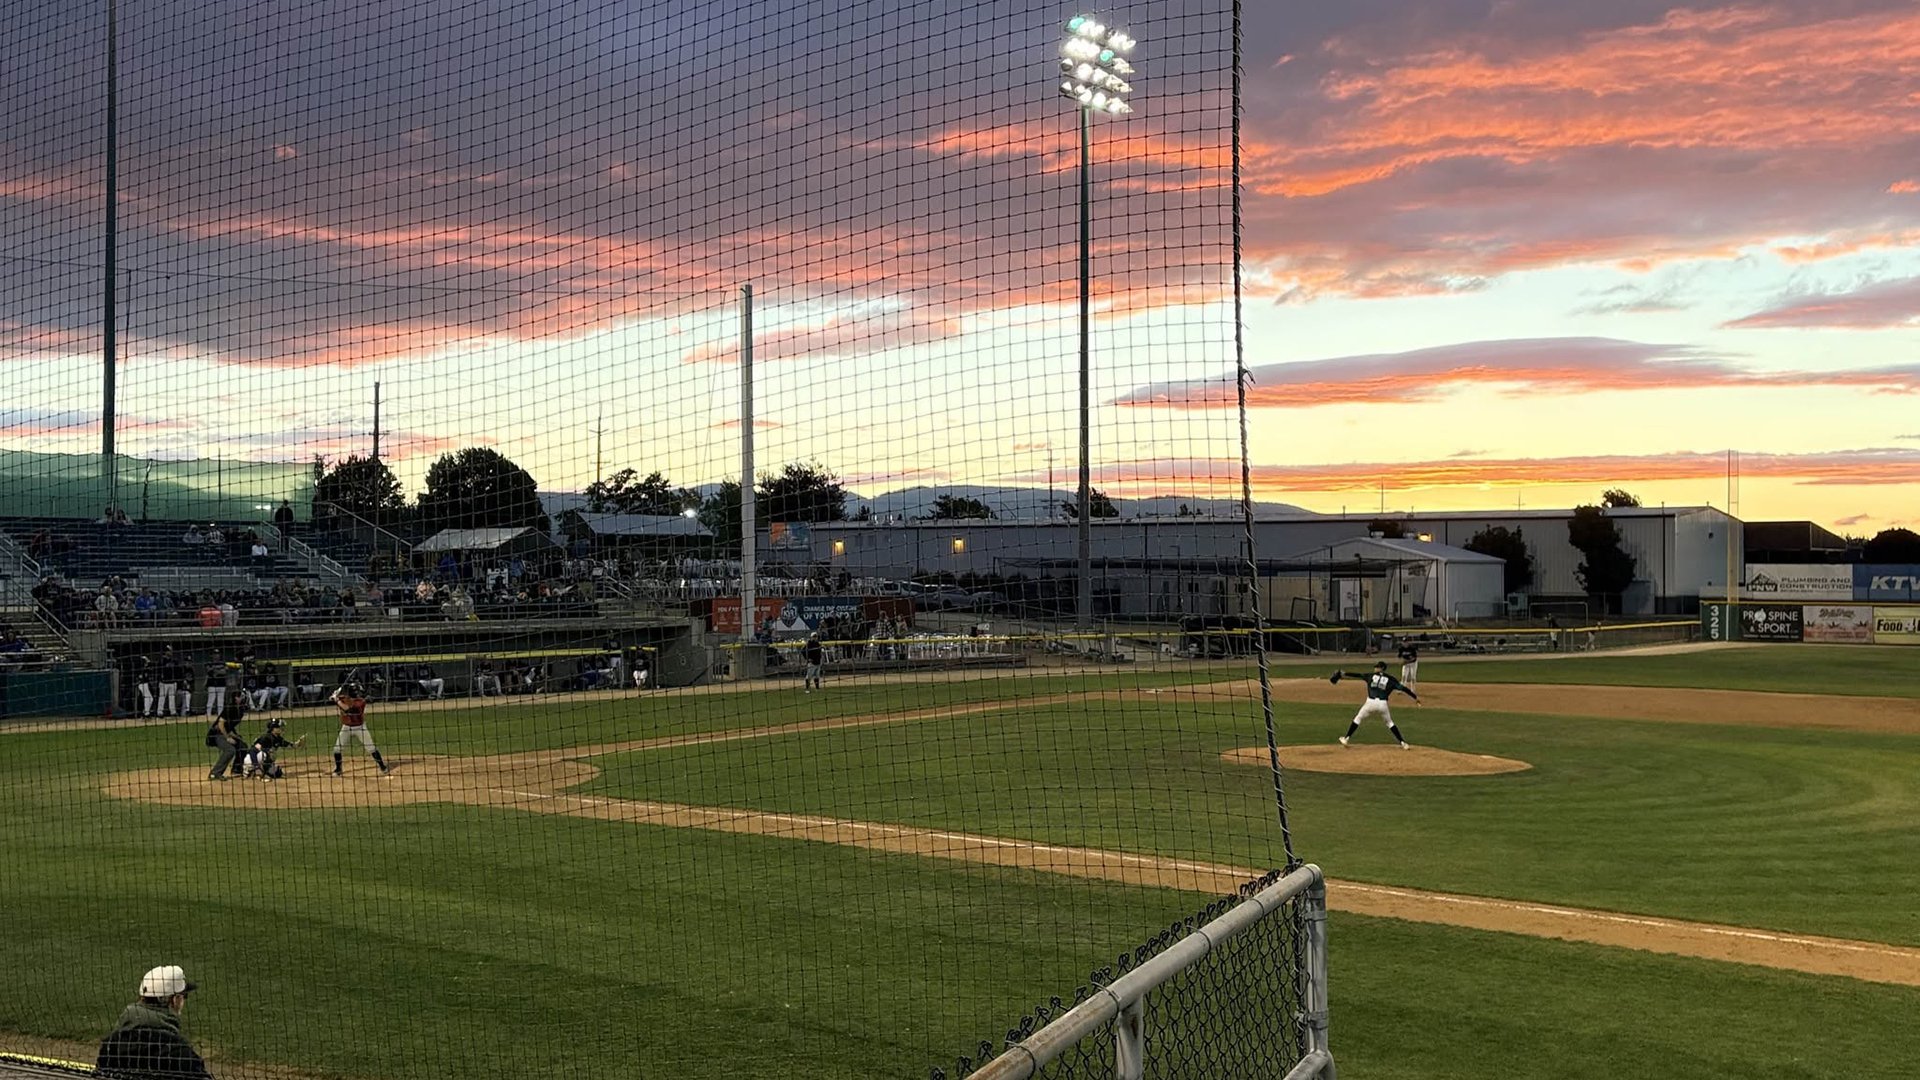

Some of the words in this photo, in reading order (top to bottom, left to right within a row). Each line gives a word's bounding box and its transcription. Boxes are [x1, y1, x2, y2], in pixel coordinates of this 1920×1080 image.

[1748, 584, 1777, 592] PNW
[1768, 610, 1798, 621] SPINE
[1710, 605, 1720, 640] 325
[1758, 622, 1791, 633] SPORT
